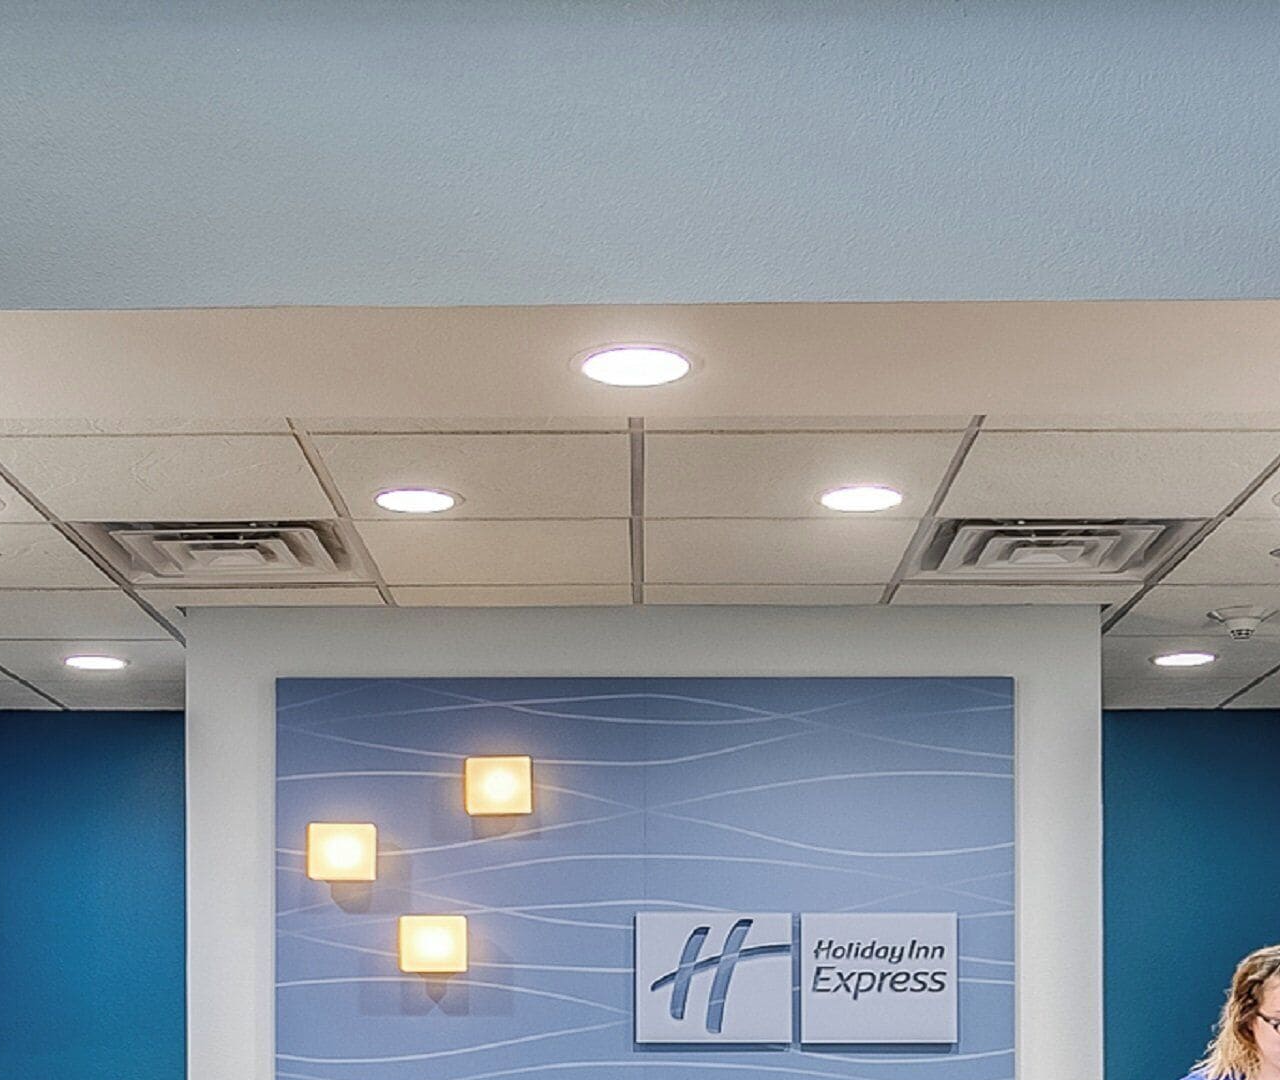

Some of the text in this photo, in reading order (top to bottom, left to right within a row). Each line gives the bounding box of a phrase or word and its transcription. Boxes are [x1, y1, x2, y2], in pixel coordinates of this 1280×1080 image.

[813, 939, 945, 965] Holiday Inn
[812, 966, 947, 1001] Express
